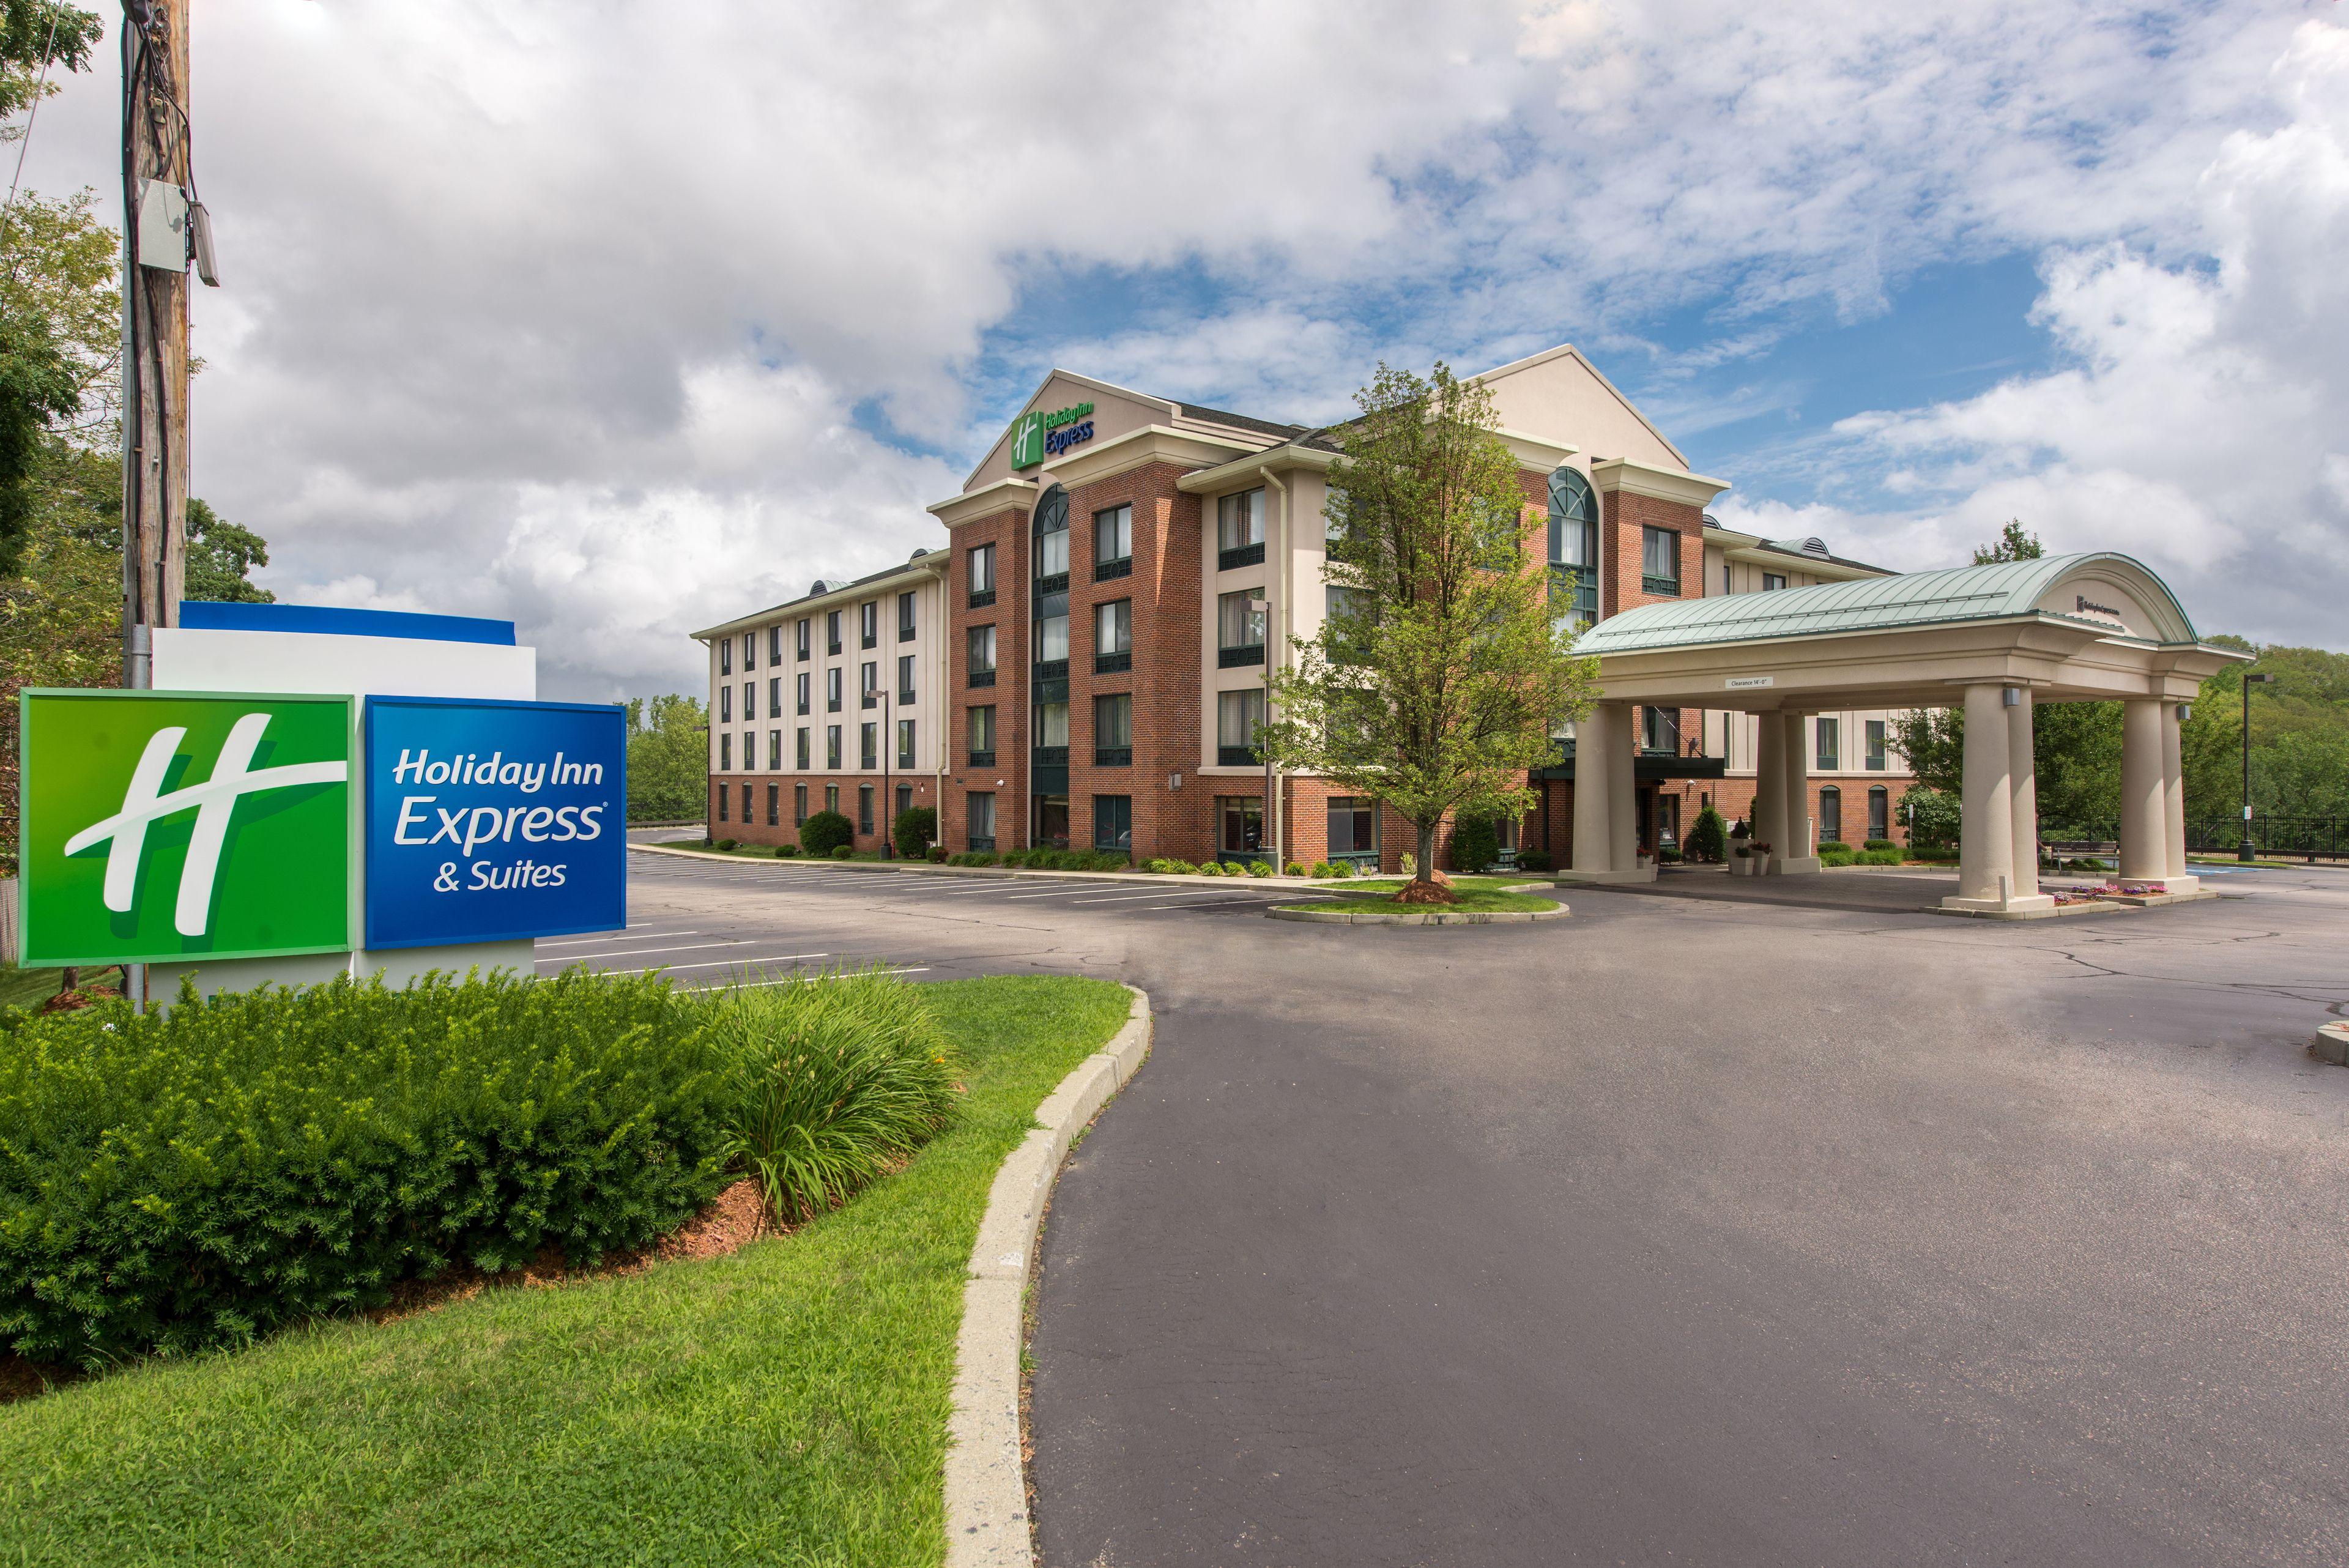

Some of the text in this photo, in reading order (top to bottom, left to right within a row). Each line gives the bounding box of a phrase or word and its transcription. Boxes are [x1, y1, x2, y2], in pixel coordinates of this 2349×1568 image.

[1045, 401, 1094, 431] Holiday Inn
[1045, 421, 1094, 455] Express
[392, 749, 604, 793] Holiday Inn
[433, 860, 567, 893] & Suites
